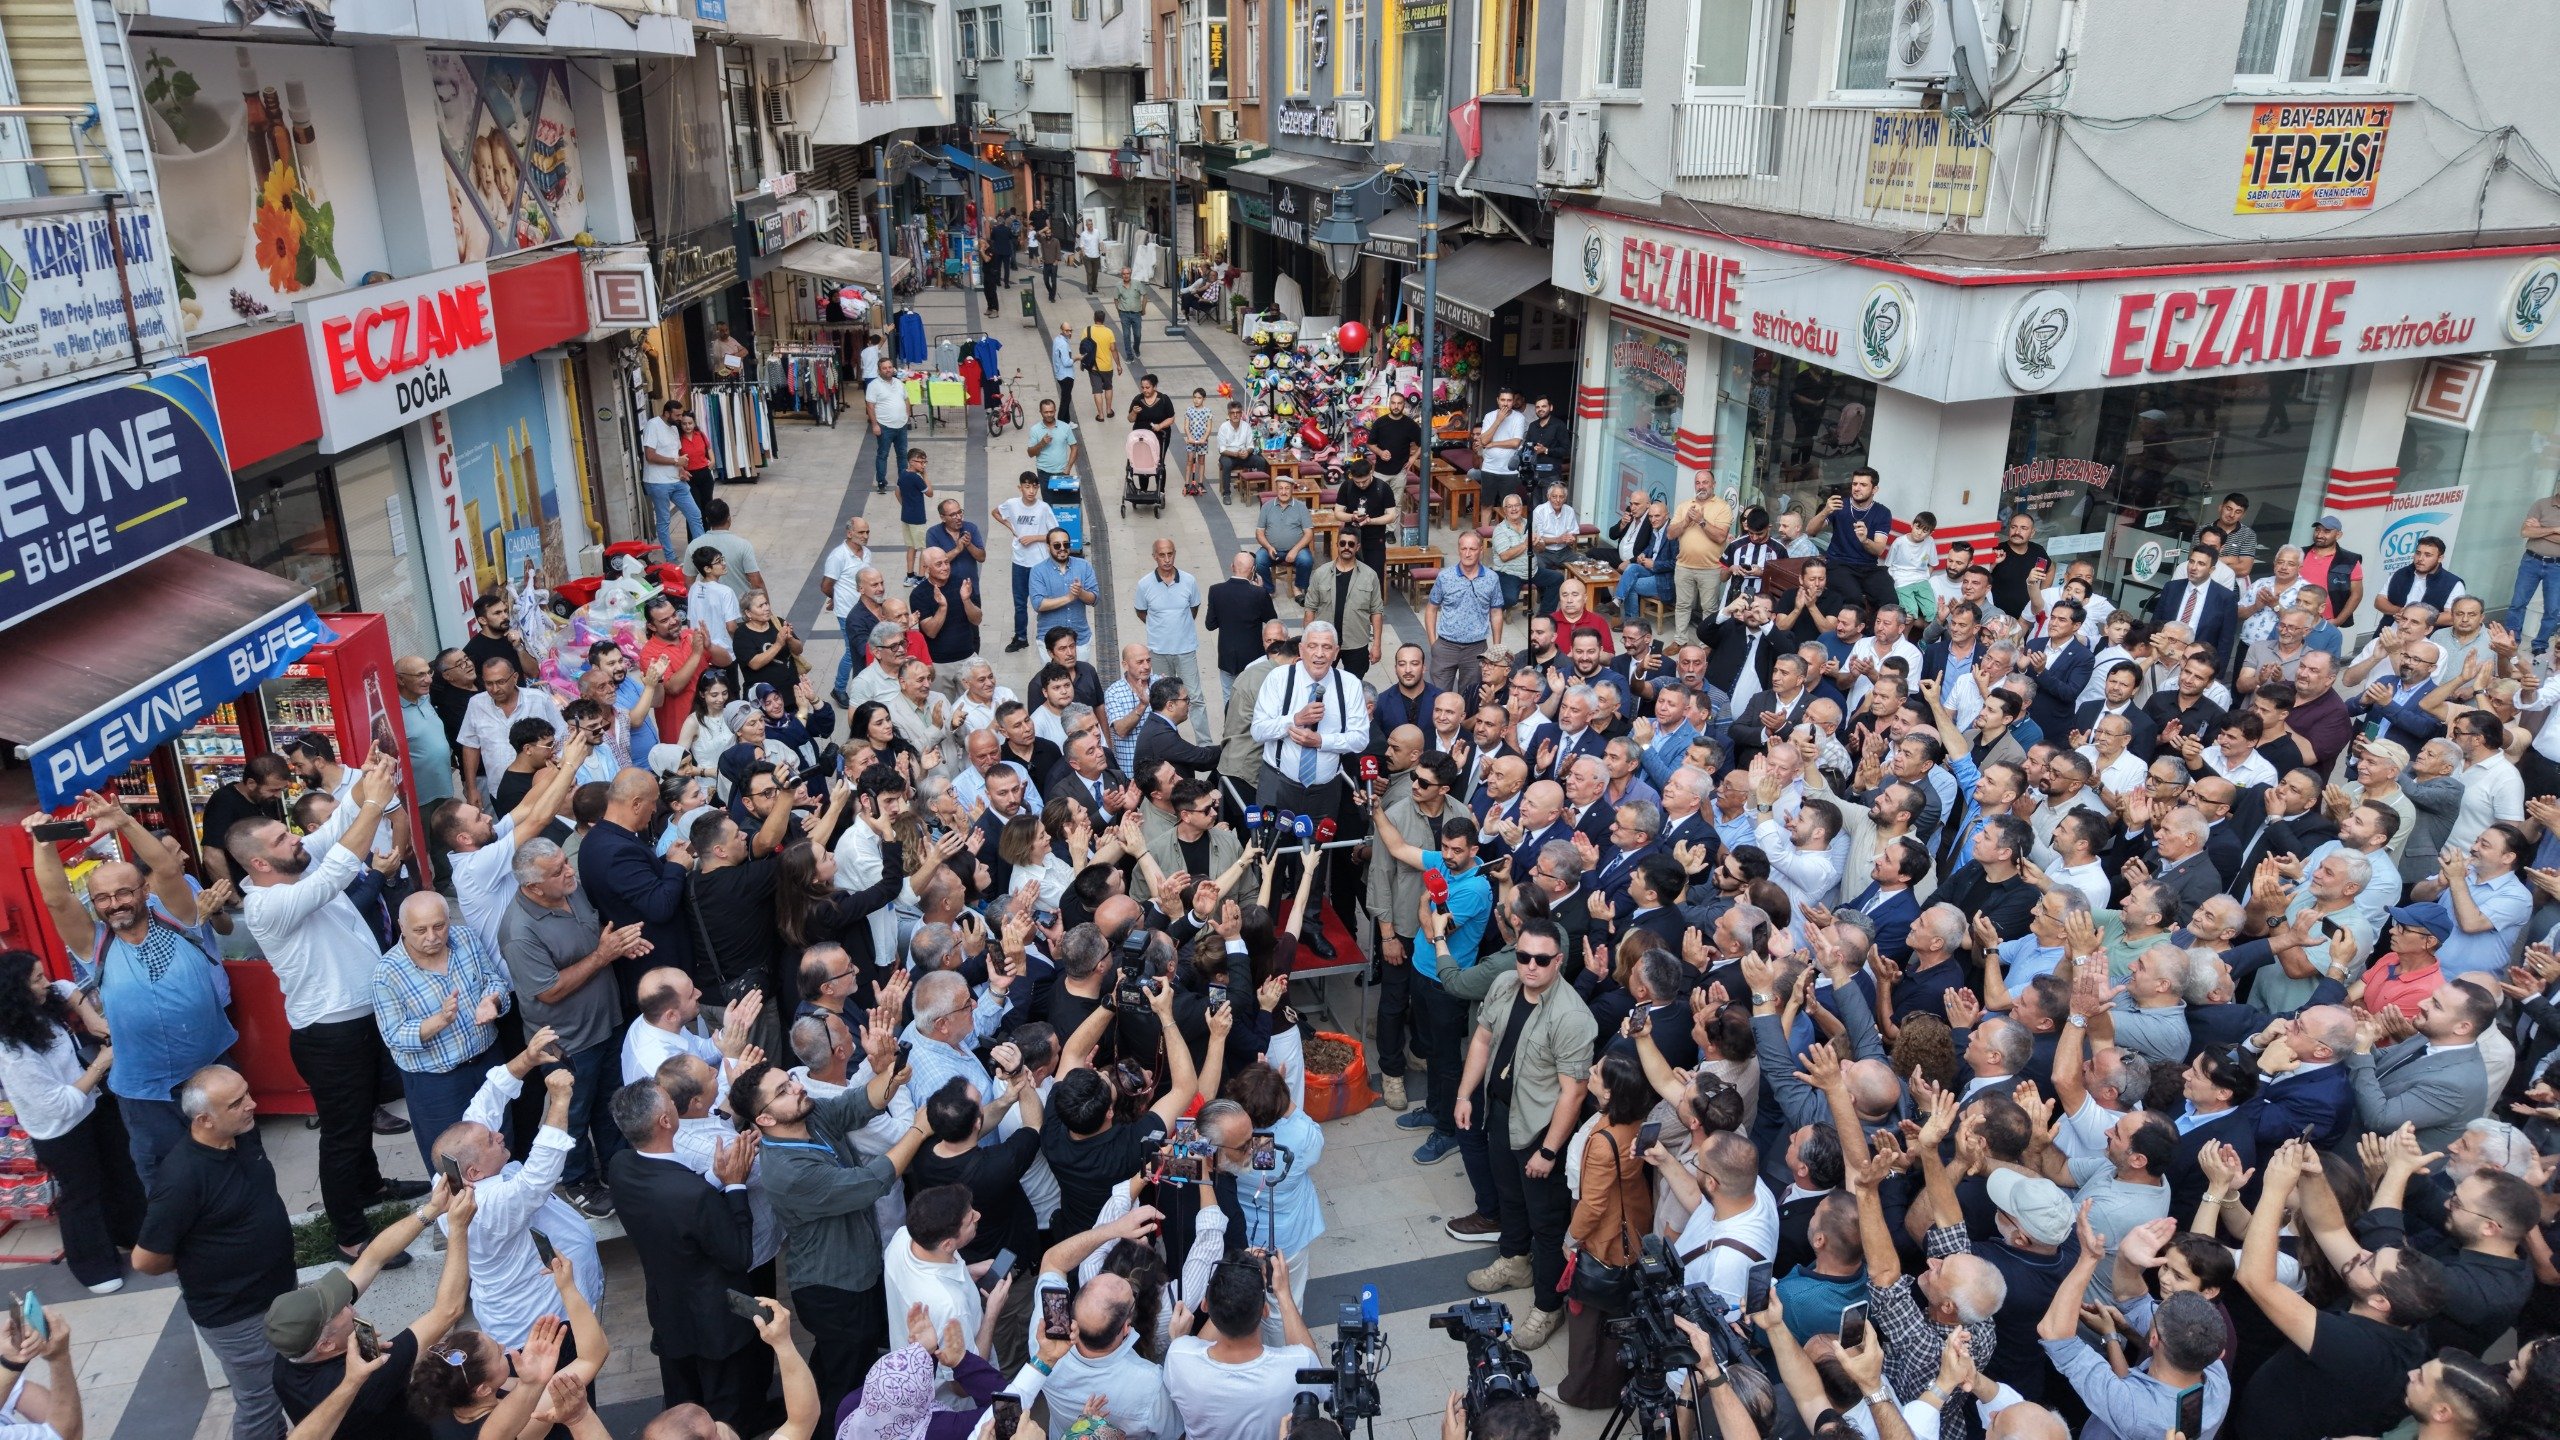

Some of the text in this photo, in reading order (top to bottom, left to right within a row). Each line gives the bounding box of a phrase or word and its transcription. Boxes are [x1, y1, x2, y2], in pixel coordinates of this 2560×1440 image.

[1211, 24, 1223, 67] TERZİ
[1278, 104, 1314, 136] Gezener
[2280, 107, 2366, 128] BAY-BAYAN
[2250, 132, 2382, 185] TERZİSİ
[2247, 187, 2369, 200] SABRİ ÖZTÜRK KENAN DEMİRCİ
[766, 214, 782, 233] NEFES
[1271, 214, 1303, 245] MODA NUR
[24, 221, 90, 288] KARŞI
[605, 278, 641, 315] E
[1620, 236, 1744, 331] ECZANE
[40, 306, 66, 329] Plan
[65, 300, 94, 326] Proje
[132, 286, 165, 309] aahhüt
[1447, 304, 1462, 323] ÇAY
[1461, 308, 1474, 330] EVİ
[2105, 280, 2356, 378] ECZANE
[53, 341, 69, 359] ve
[68, 330, 91, 355] Plan
[117, 316, 166, 344] Himetleri
[322, 279, 494, 395] ECZANE
[1752, 309, 1839, 358] SEYİTOĞLU
[2358, 311, 2476, 352] SEYİTOĞLU
[395, 365, 452, 415] DOĞA
[2426, 367, 2472, 412] E
[0, 407, 183, 542] EVNE
[2055, 458, 2116, 490] ECZANESİ
[2422, 489, 2464, 507] ECZANESİ
[19, 515, 113, 586] BÜFE
[229, 614, 317, 687] BÜFE
[48, 673, 203, 795] PLEVNE
